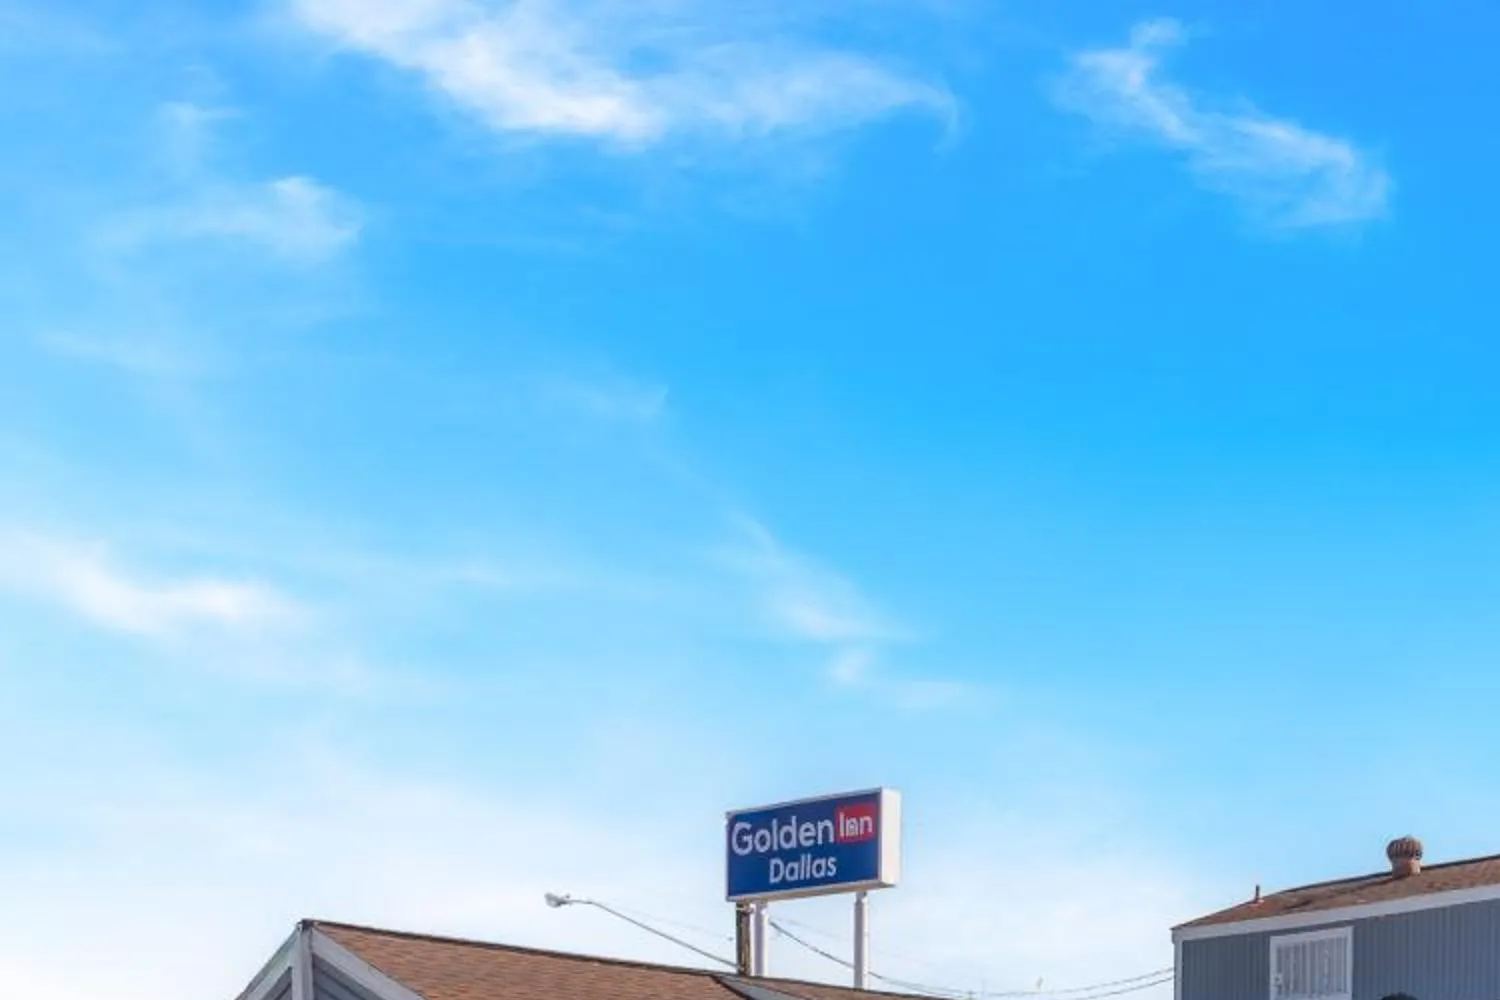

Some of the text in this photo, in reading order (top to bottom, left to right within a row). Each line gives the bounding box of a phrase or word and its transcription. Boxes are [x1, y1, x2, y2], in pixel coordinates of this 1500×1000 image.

[732, 812, 872, 855] Golden Inn
[769, 854, 837, 883] Dallas
